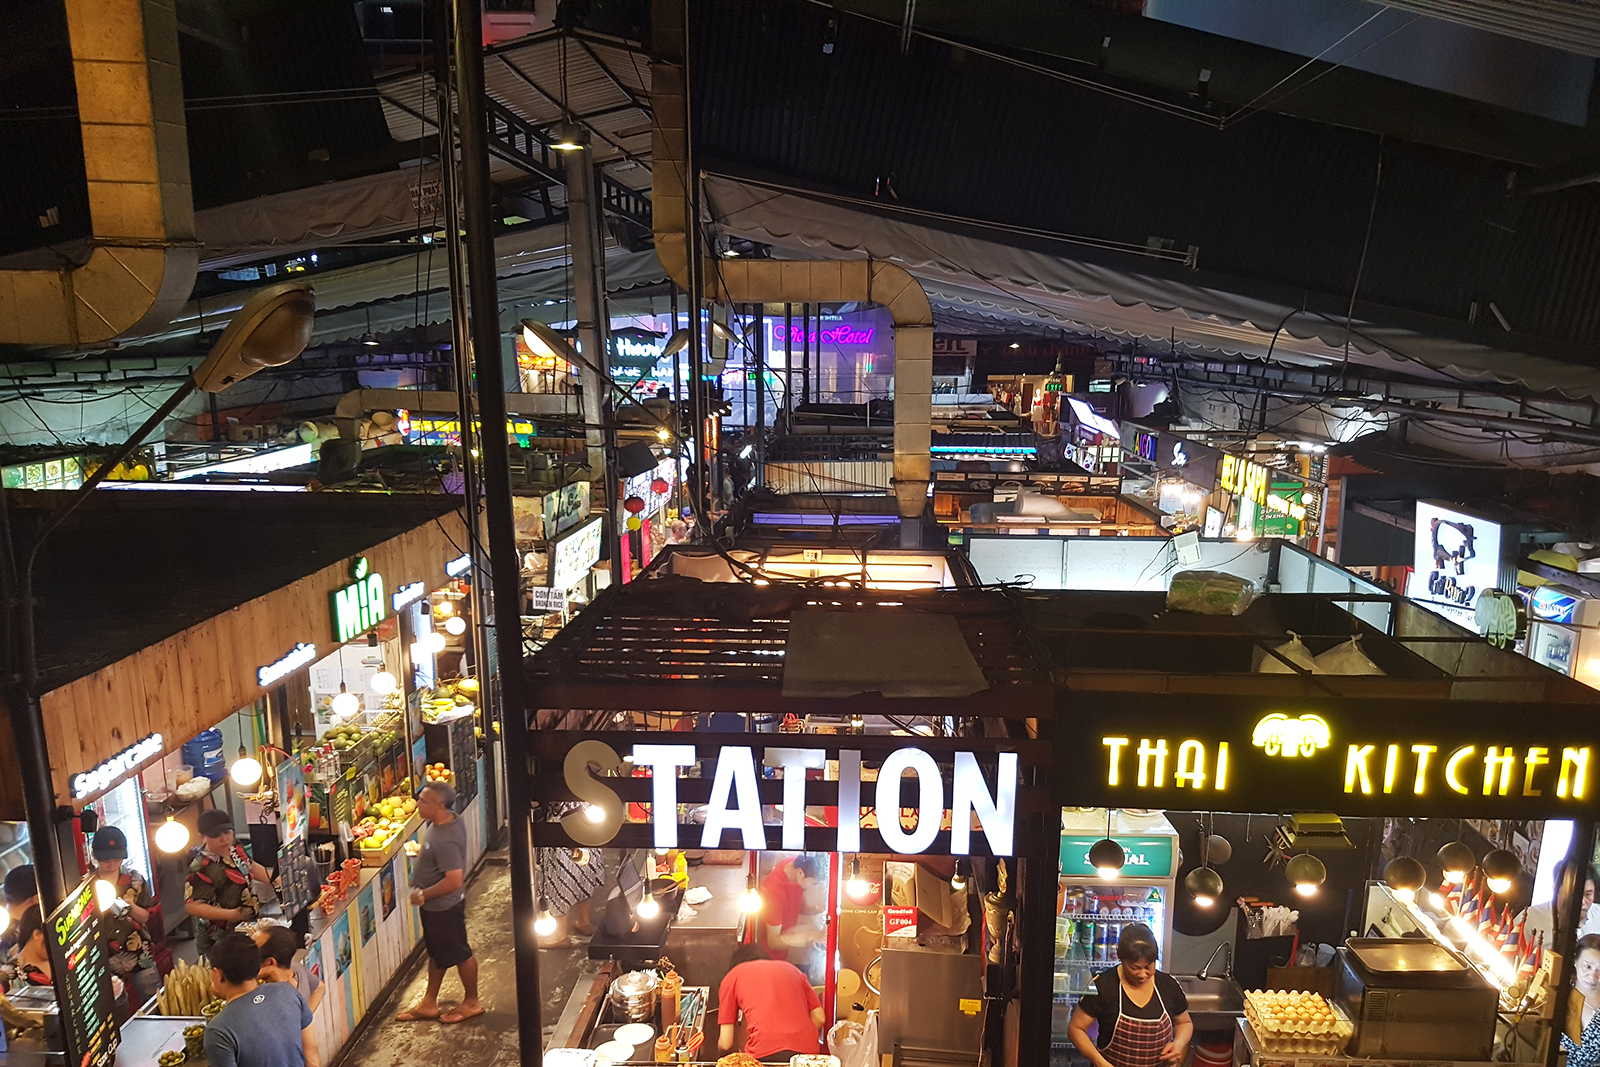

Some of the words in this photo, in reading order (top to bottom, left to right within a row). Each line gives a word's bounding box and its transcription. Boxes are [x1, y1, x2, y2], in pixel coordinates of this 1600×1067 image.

[820, 325, 874, 344] Hotel
[553, 600, 564, 609] RICE
[73, 732, 163, 800] Sugarcane
[1101, 736, 1230, 792] THAI
[1343, 744, 1592, 800] KITCHEN
[561, 739, 1019, 857] STATION
[889, 918, 912, 926] GF004
